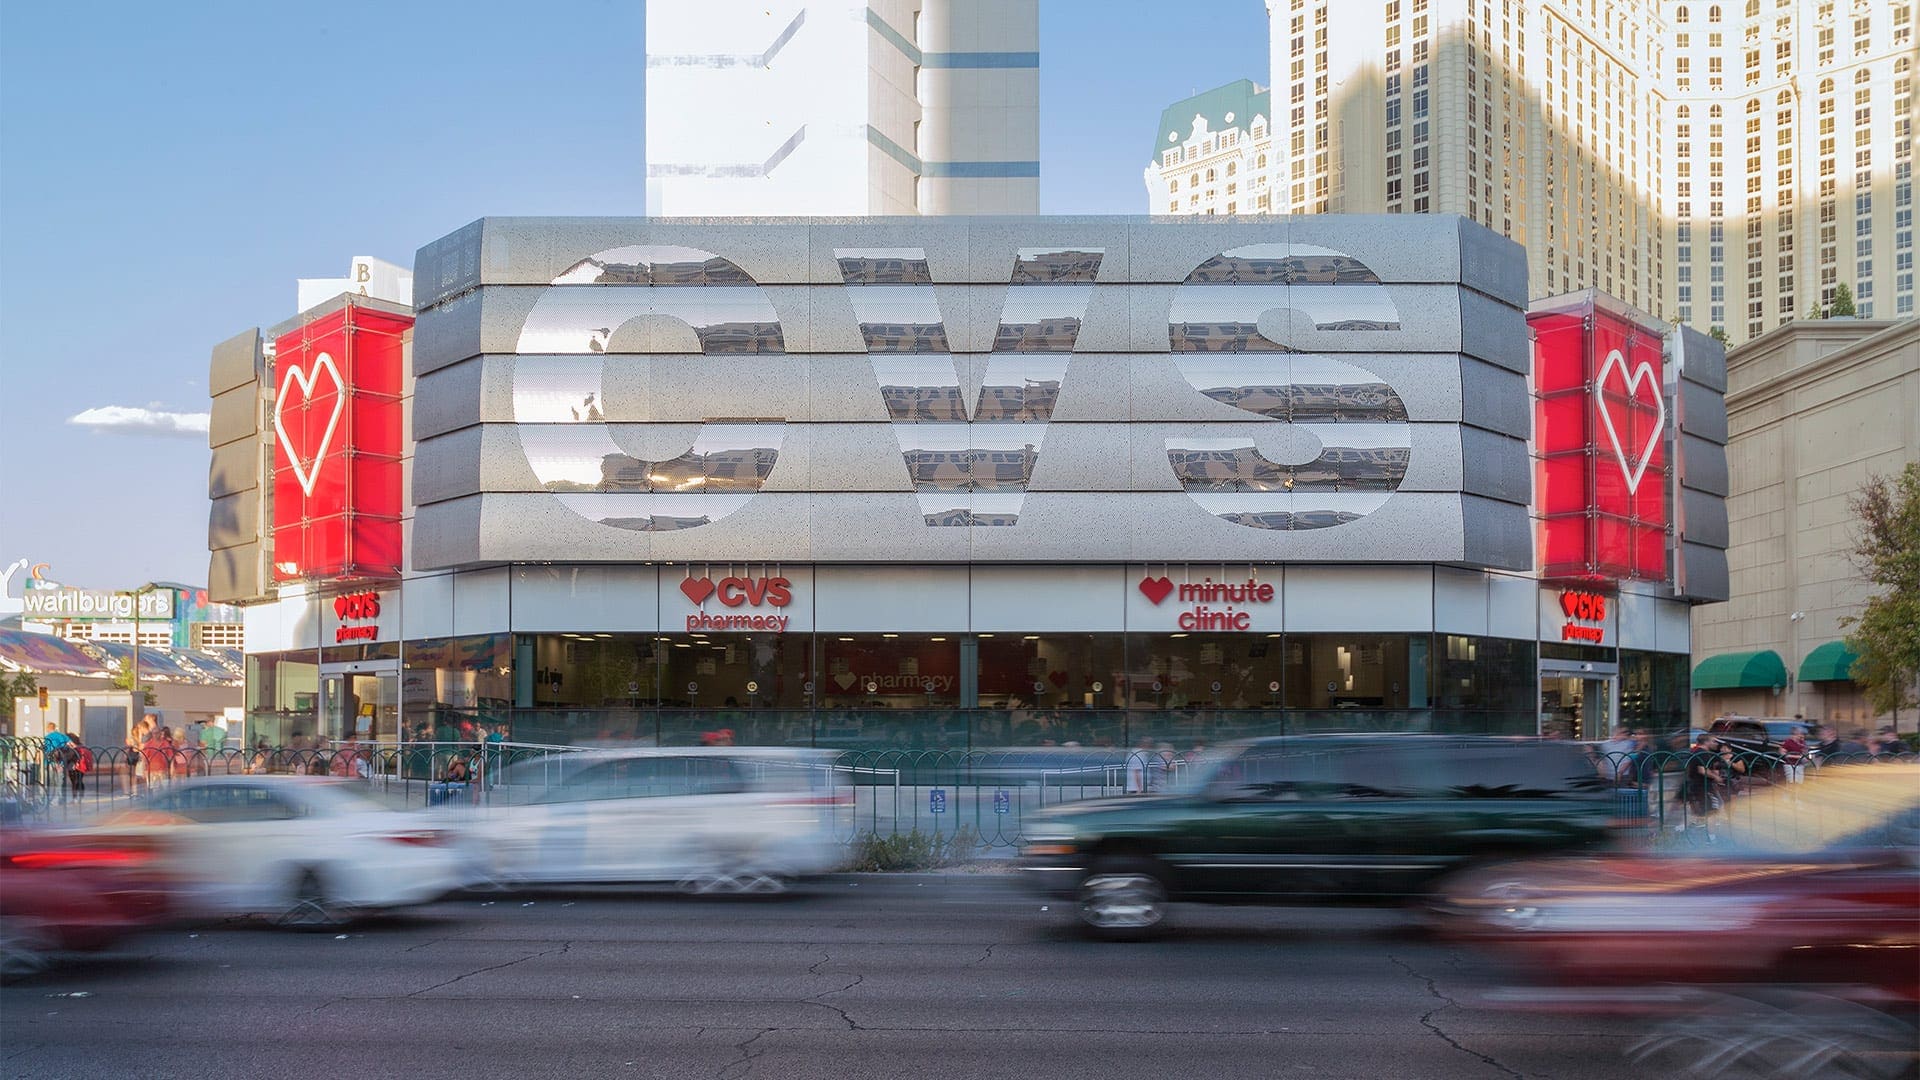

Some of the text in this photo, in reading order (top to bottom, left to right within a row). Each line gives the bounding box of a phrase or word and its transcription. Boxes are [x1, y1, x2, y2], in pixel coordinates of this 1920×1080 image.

[512, 242, 1412, 531] CVS
[717, 577, 792, 607] CVS
[1178, 577, 1274, 602] minute
[24, 590, 169, 617] wahlburgers
[347, 592, 380, 620] CVS
[1575, 592, 1606, 621] CVS
[686, 611, 789, 633] pharmacy
[1178, 606, 1250, 630] clinic
[860, 671, 954, 691] pharmacy
